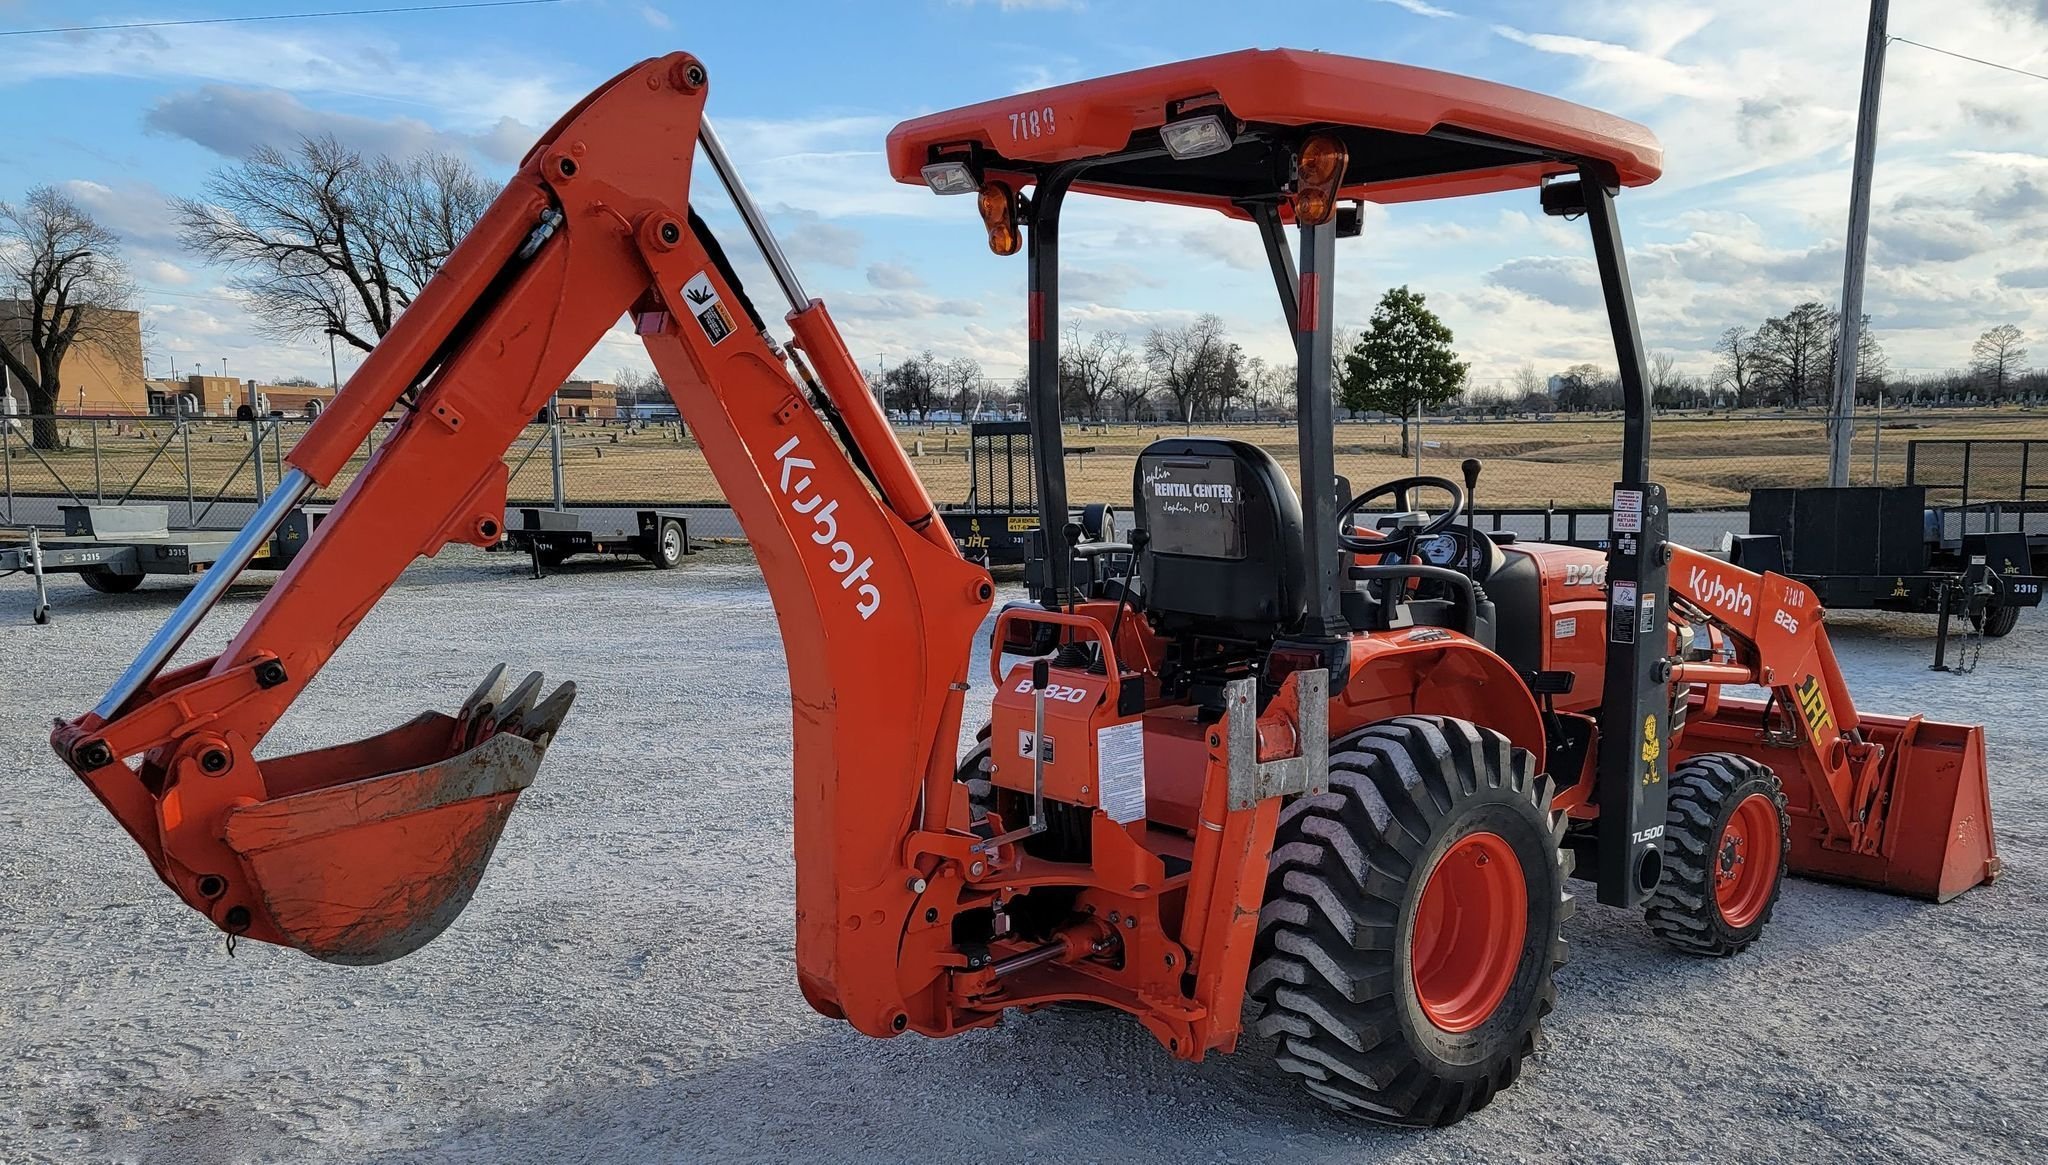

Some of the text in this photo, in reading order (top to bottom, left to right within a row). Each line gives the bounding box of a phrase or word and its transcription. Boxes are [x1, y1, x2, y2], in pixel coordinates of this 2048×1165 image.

[1154, 483, 1233, 498] RENTAL CENTER
[1162, 501, 1210, 514] Joplin, MO
[773, 435, 881, 620] Kubota
[965, 537, 990, 547] JRC
[81, 552, 101, 562] 3315
[168, 548, 186, 557] 3315
[2003, 566, 2020, 574] JRC
[1689, 565, 1753, 617] Kubota
[1890, 588, 1911, 597] JRC
[2014, 584, 2038, 593] 3316
[1774, 608, 1801, 634] B26
[1014, 679, 1087, 703] B820
[1798, 677, 1834, 746] JRC
[1632, 825, 1664, 844] TL500
